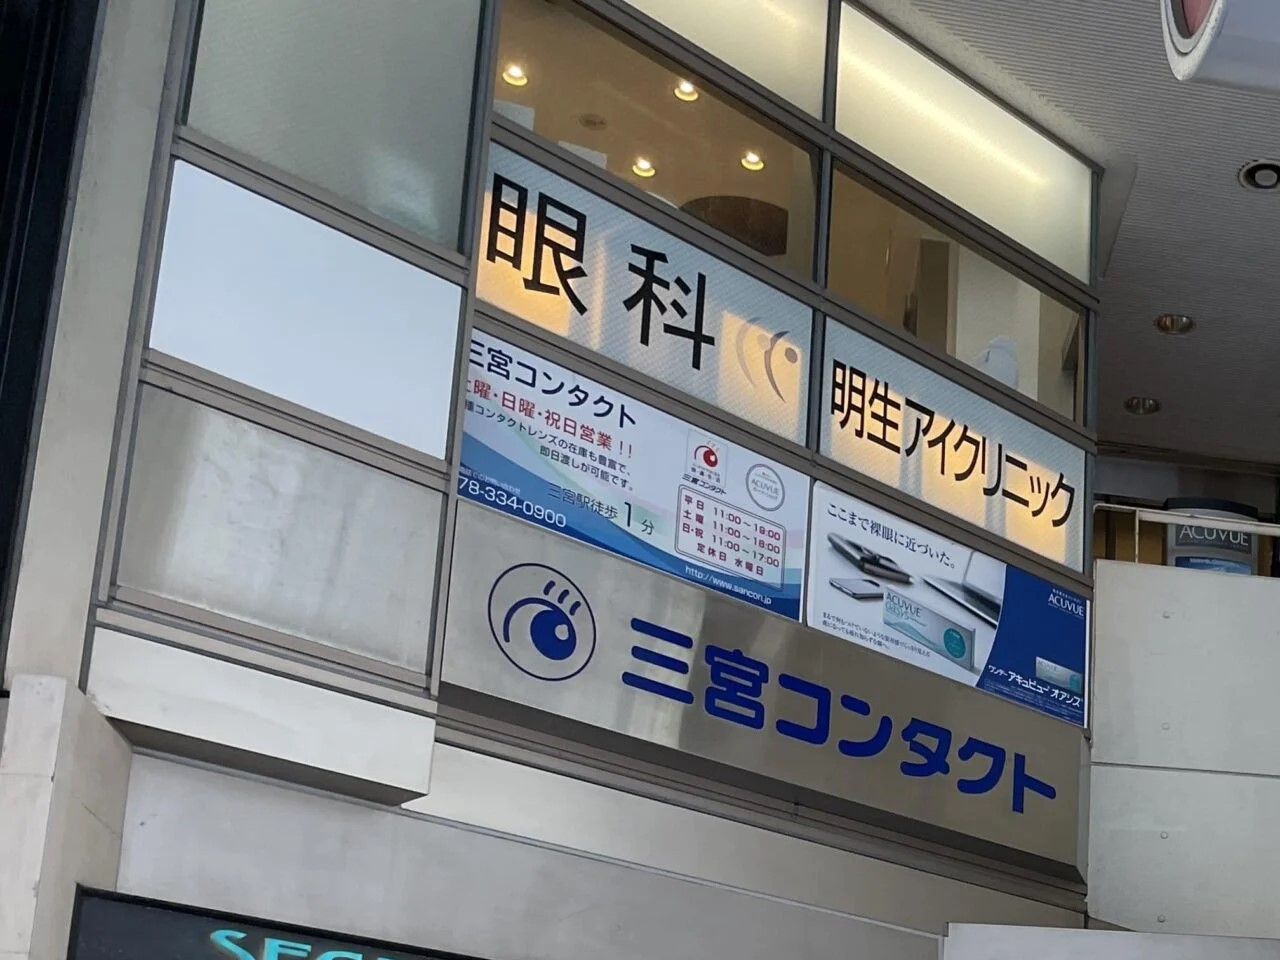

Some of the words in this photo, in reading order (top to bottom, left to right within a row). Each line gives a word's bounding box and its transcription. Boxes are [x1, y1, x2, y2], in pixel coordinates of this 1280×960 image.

[486, 173, 715, 370] 眼科
[831, 359, 1076, 528] 明生アイクリニック
[685, 495, 704, 510] 平日
[697, 542, 726, 561] 定休日
[735, 557, 763, 576] 水曜日
[827, 503, 955, 569] ここまで裸眼に近づいた。
[886, 592, 922, 617] ACUVUE
[1048, 593, 1084, 617] ACUVUE
[621, 616, 1057, 814] 三宮コンタクト
